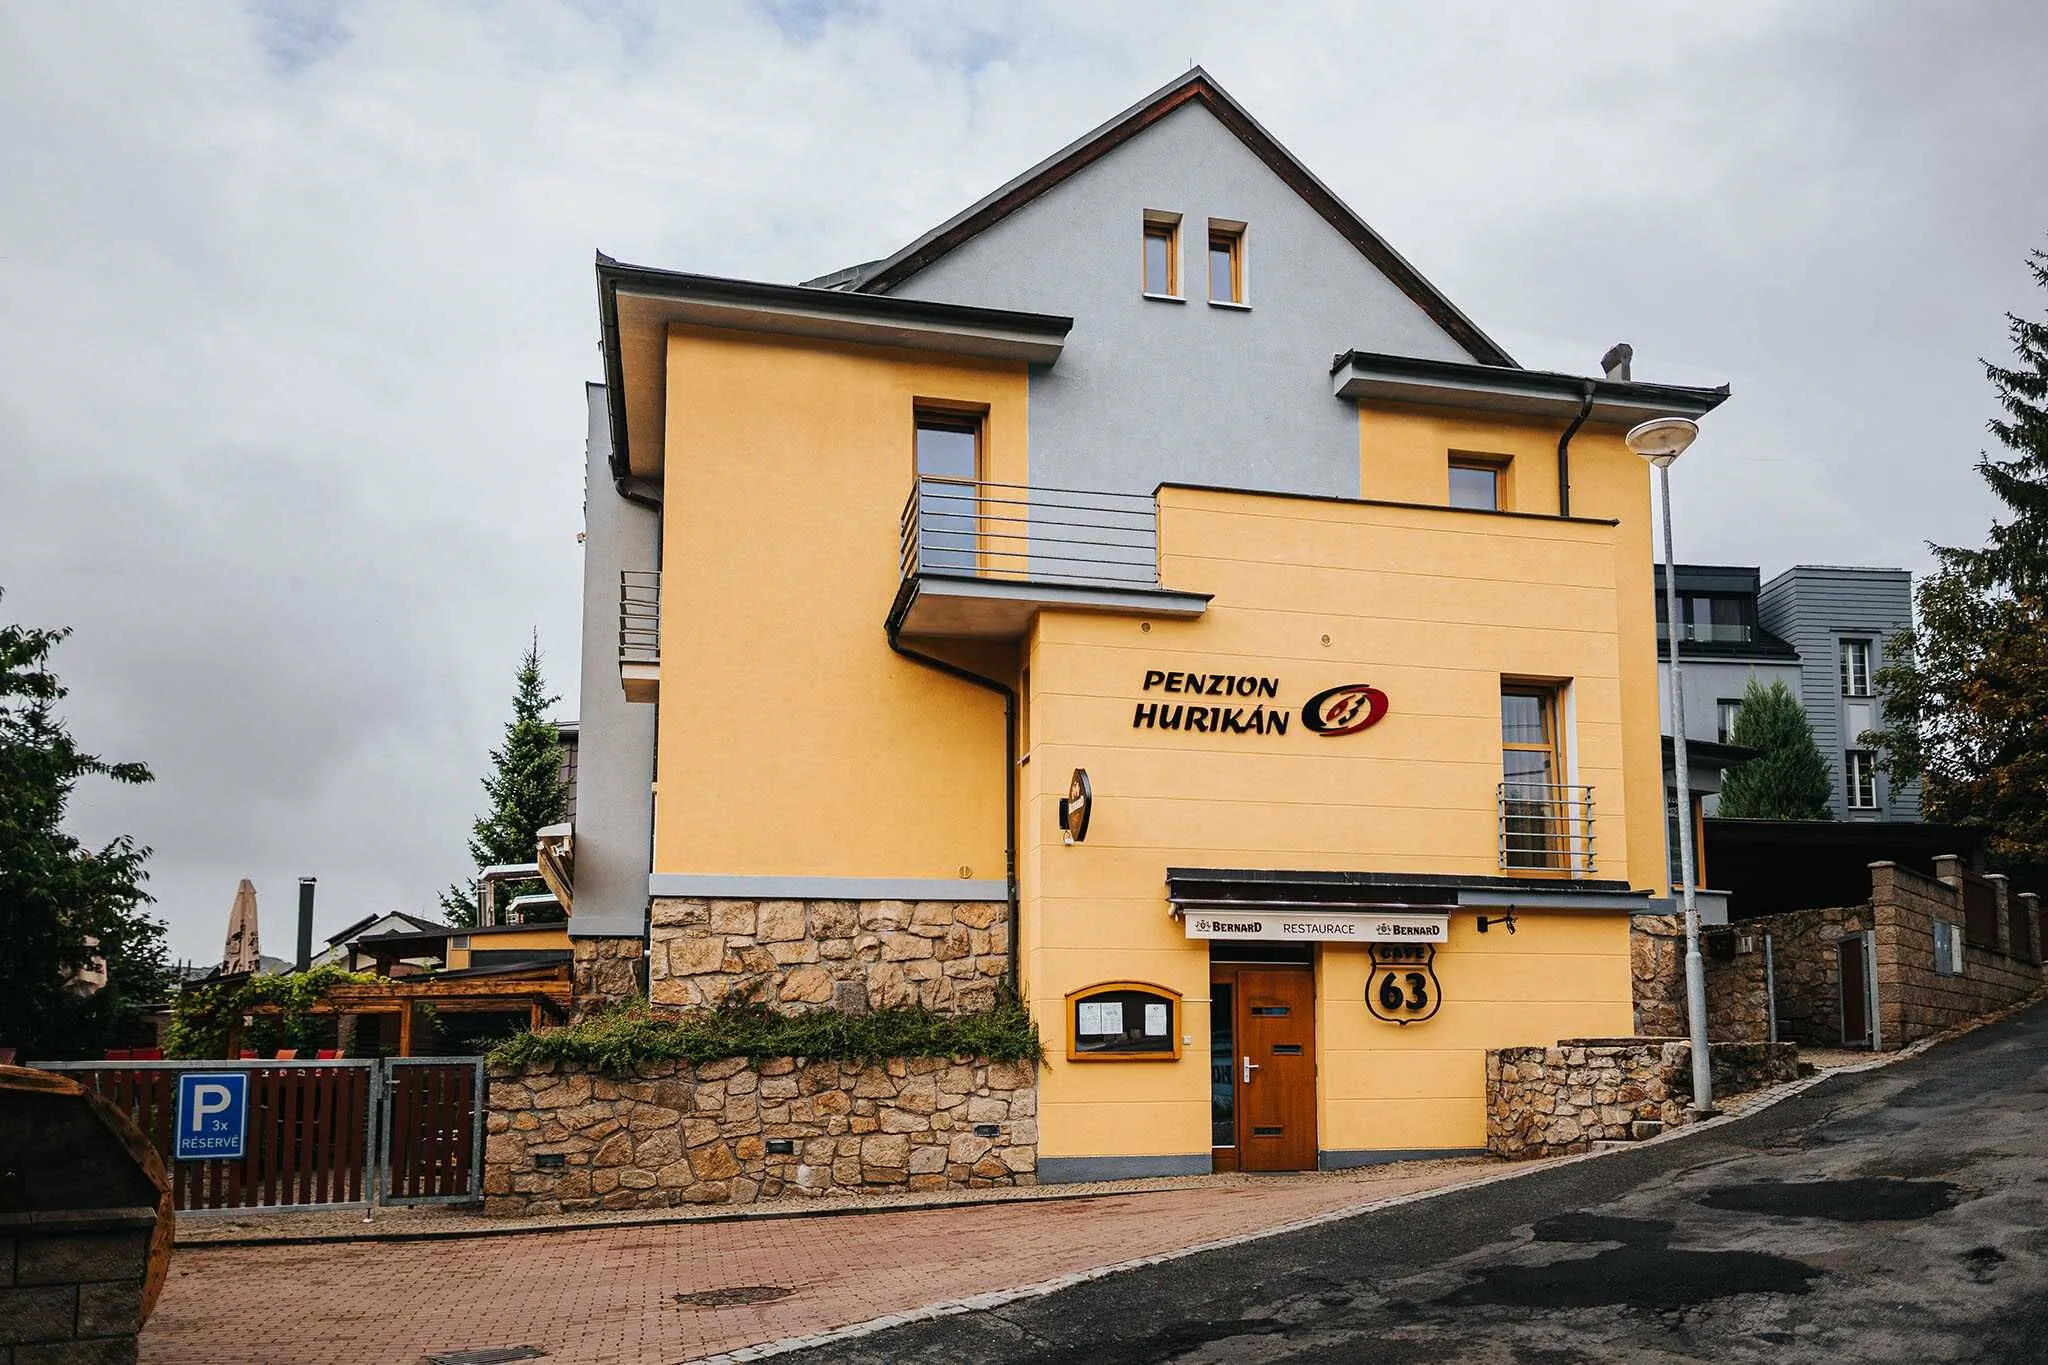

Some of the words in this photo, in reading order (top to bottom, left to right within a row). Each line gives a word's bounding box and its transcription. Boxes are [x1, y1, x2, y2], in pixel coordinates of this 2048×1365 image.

[1143, 670, 1279, 698] PENZION
[1133, 703, 1290, 736] HURIKÁN
[1212, 921, 1262, 933] BERNARD
[1283, 923, 1356, 935] RESTAURACE
[1393, 924, 1440, 936] BERNARD
[1380, 971, 1428, 1011] 63
[192, 1084, 232, 1132] P
[212, 1119, 228, 1131] 3x
